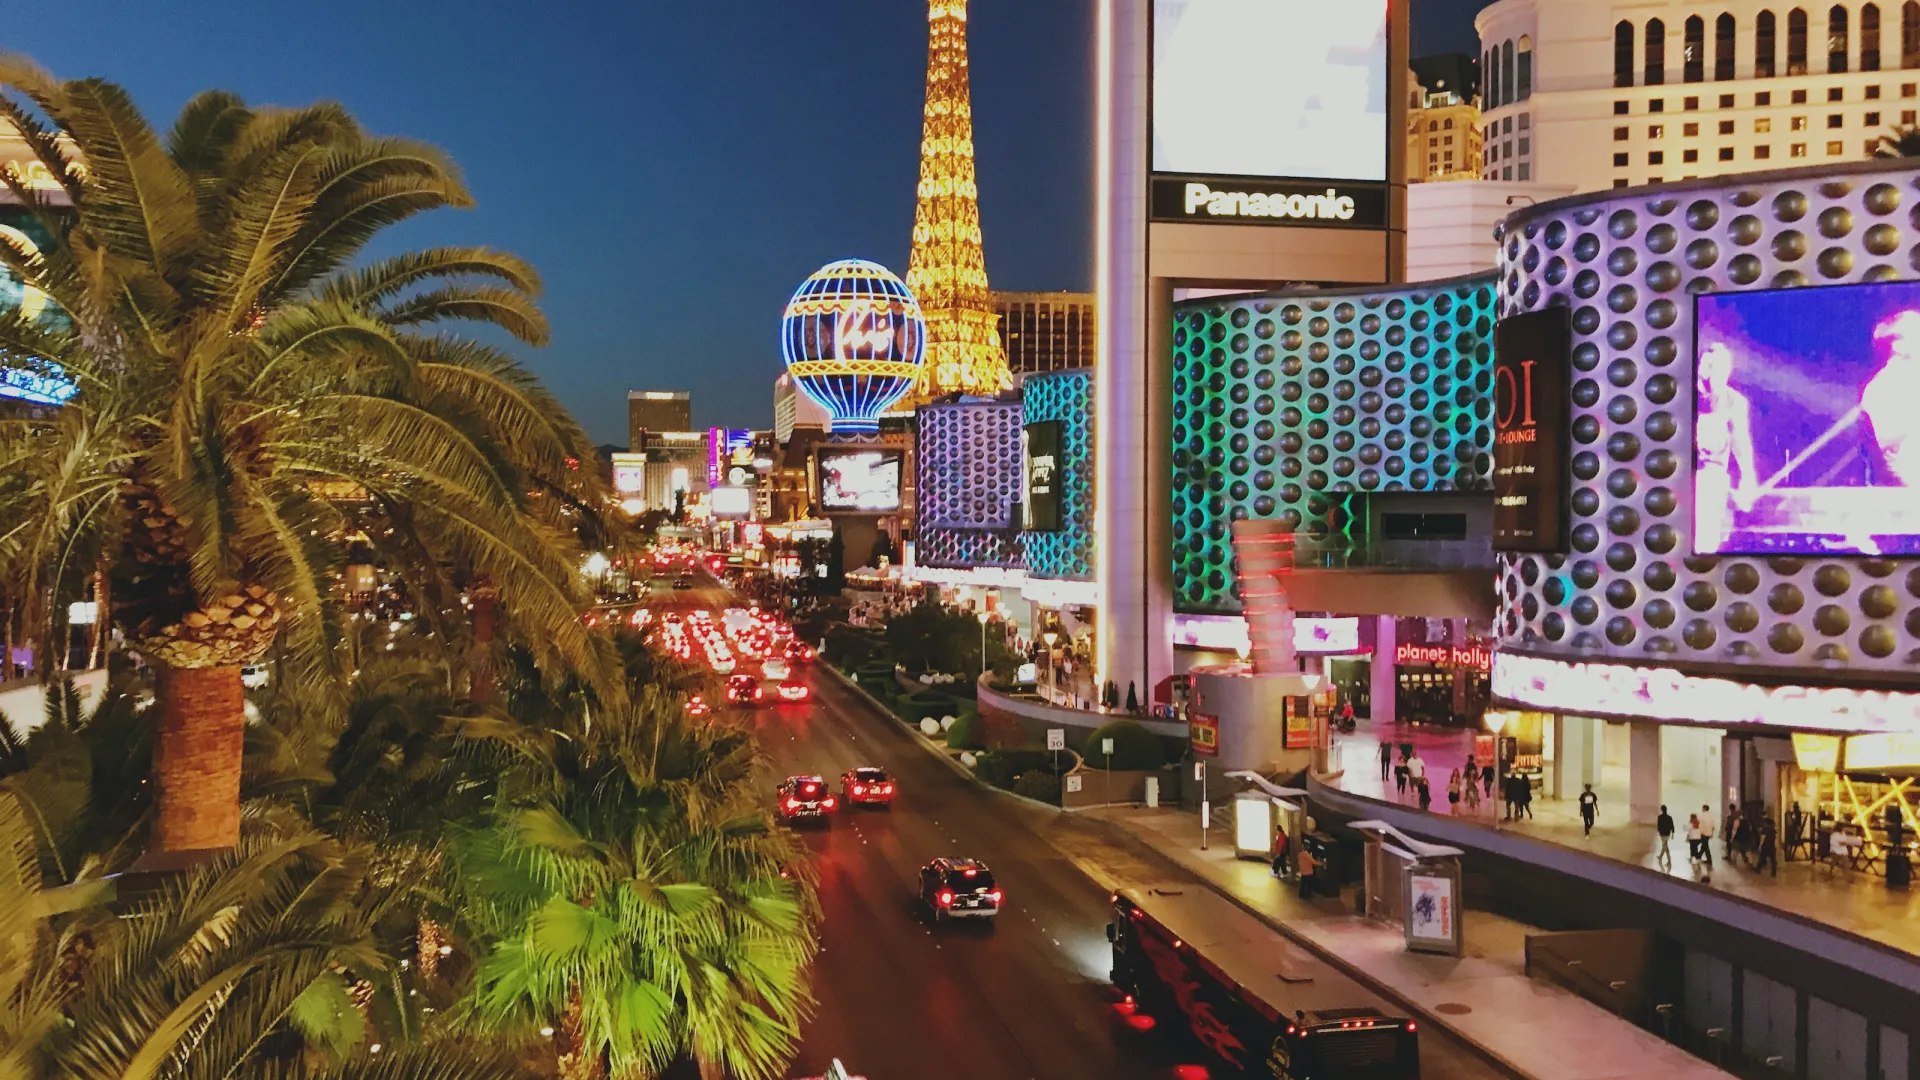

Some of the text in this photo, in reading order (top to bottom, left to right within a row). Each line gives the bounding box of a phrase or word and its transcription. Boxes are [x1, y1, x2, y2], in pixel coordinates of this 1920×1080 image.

[1184, 182, 1355, 220] Panasonic
[1397, 643, 1447, 662] planet
[1452, 646, 1492, 670] holly
[1050, 740, 1063, 748] 30
